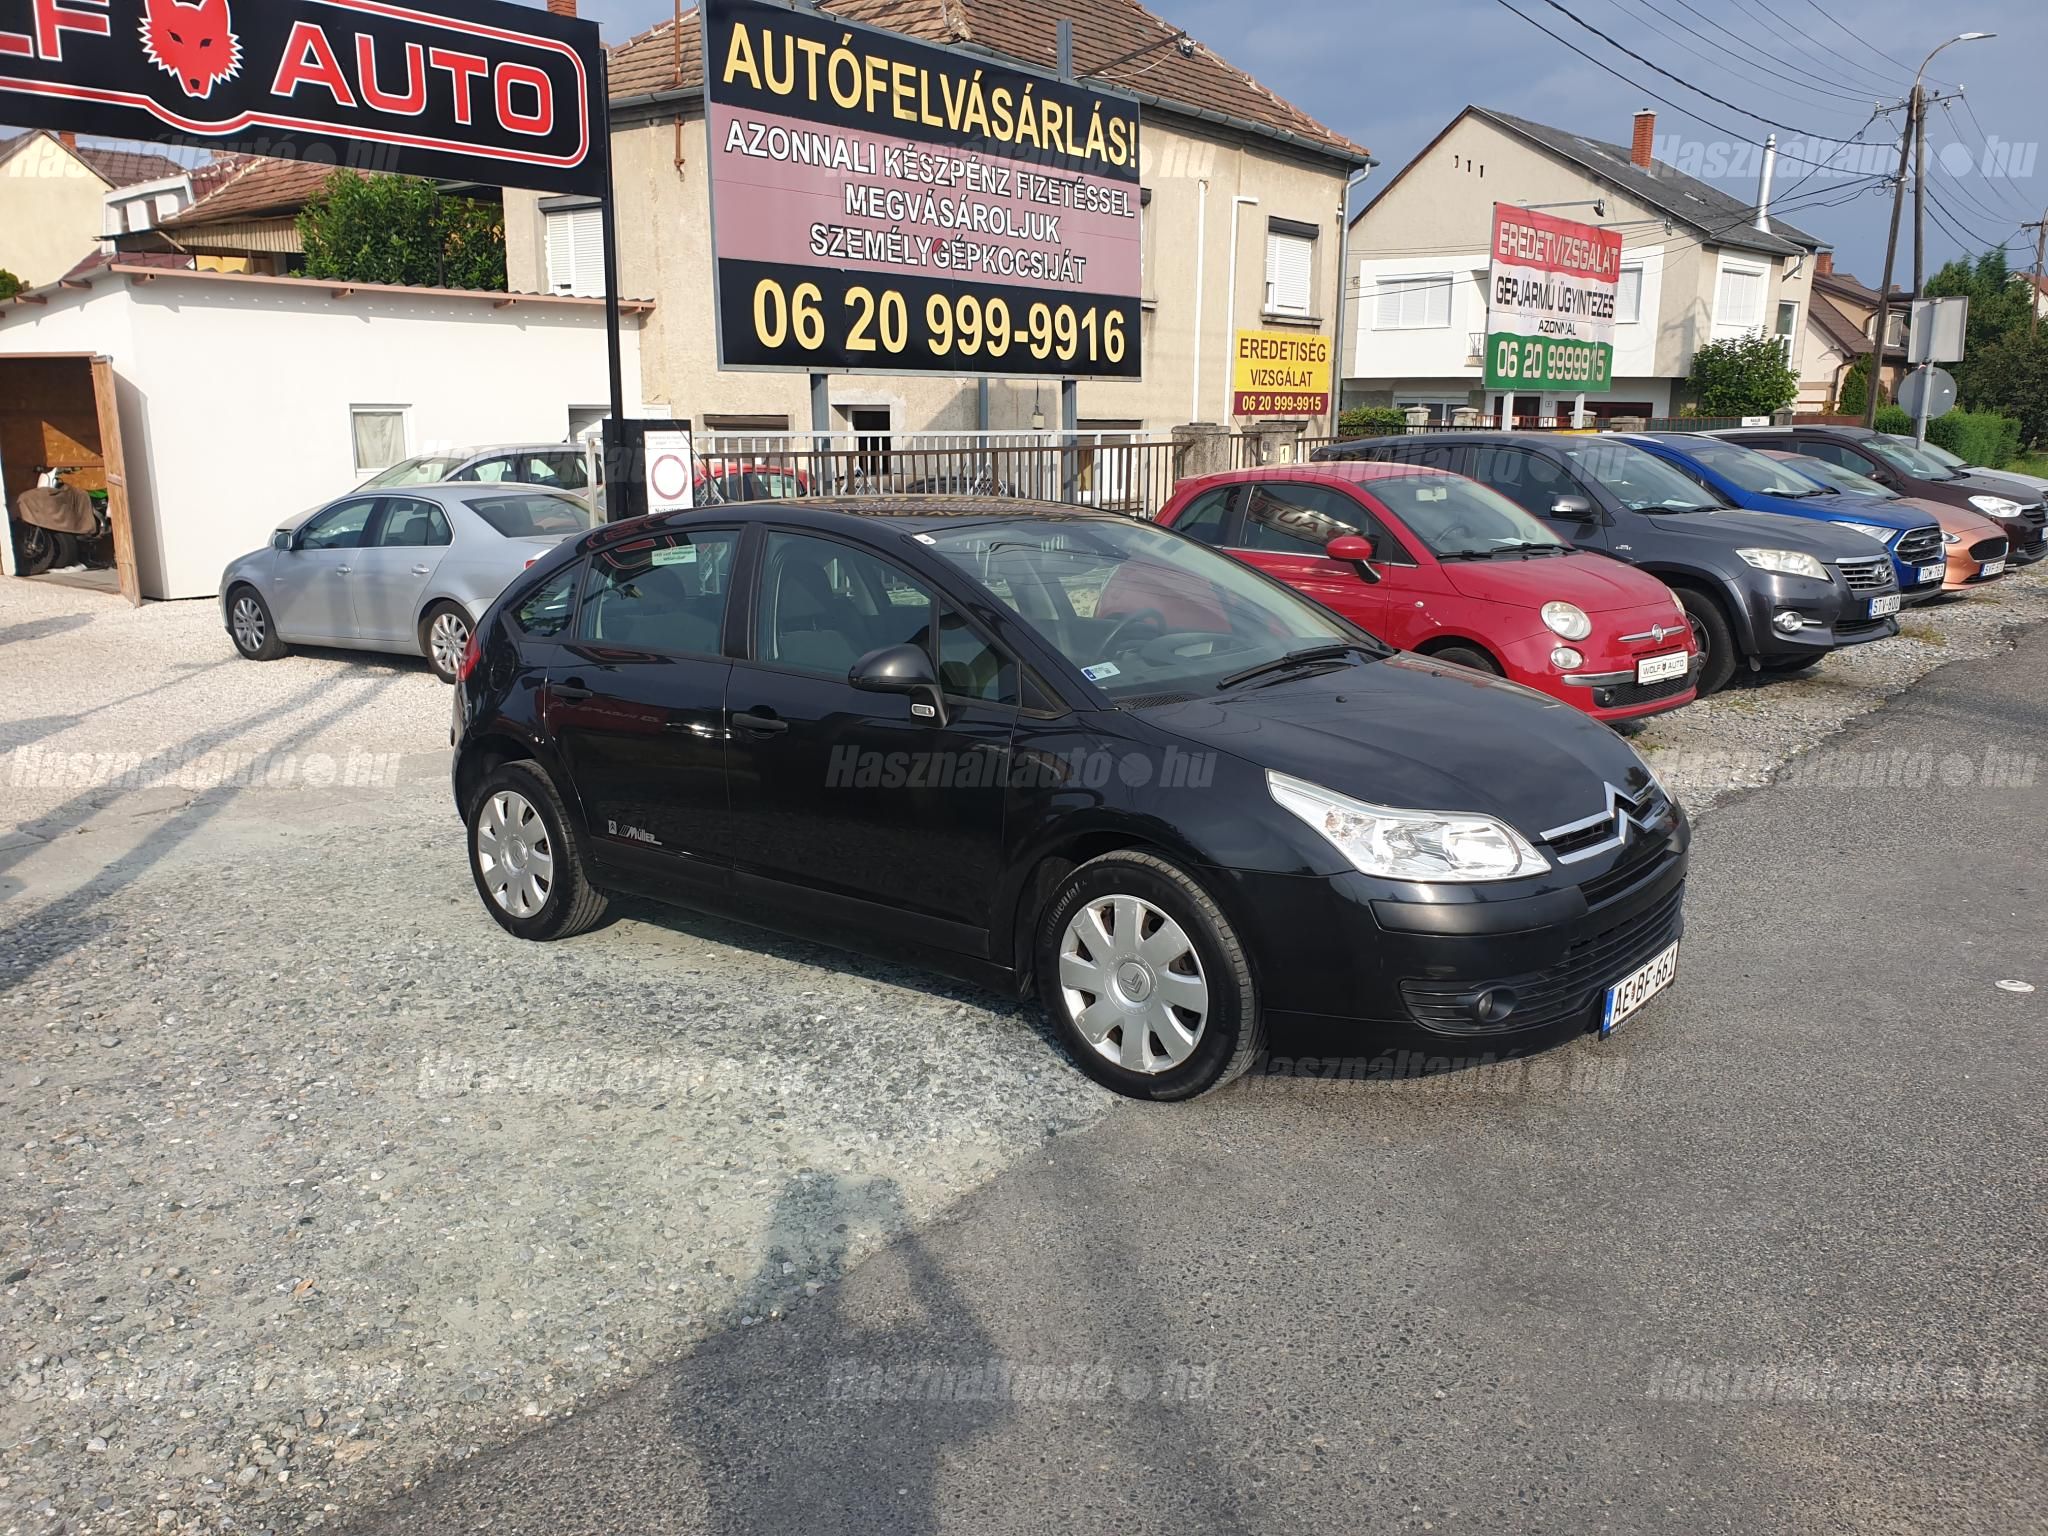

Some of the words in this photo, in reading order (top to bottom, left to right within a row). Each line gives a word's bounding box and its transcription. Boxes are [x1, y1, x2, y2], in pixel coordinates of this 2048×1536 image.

[270, 20, 555, 136] AUTO
[722, 22, 1137, 168] AUTÓFELVÁSÁRLÁS!
[725, 120, 877, 176] AZONNALI
[884, 144, 1012, 198] KÉSZPÉNZ
[1017, 171, 1136, 218] FIZETÉSSEL
[845, 183, 1061, 243] MEGVÁSÁROLJUK
[809, 223, 1087, 284] SZEMÉLYGÉPKOCSIJÁT
[1498, 221, 1619, 276] EREDETVIZSGÁLAT
[753, 278, 825, 350] 06
[844, 286, 908, 354] 20
[925, 293, 1125, 363] 999-9916
[1537, 320, 1577, 336] AZONNAL
[1240, 337, 1326, 362] EREDETISÉG
[1250, 366, 1313, 387] VIZSGÁLAT
[1496, 341, 1519, 378] 06
[1523, 343, 1543, 379] 20
[1242, 395, 1256, 411] 06
[1259, 396, 1271, 411] 20
[1274, 396, 1322, 411] 999-9915
